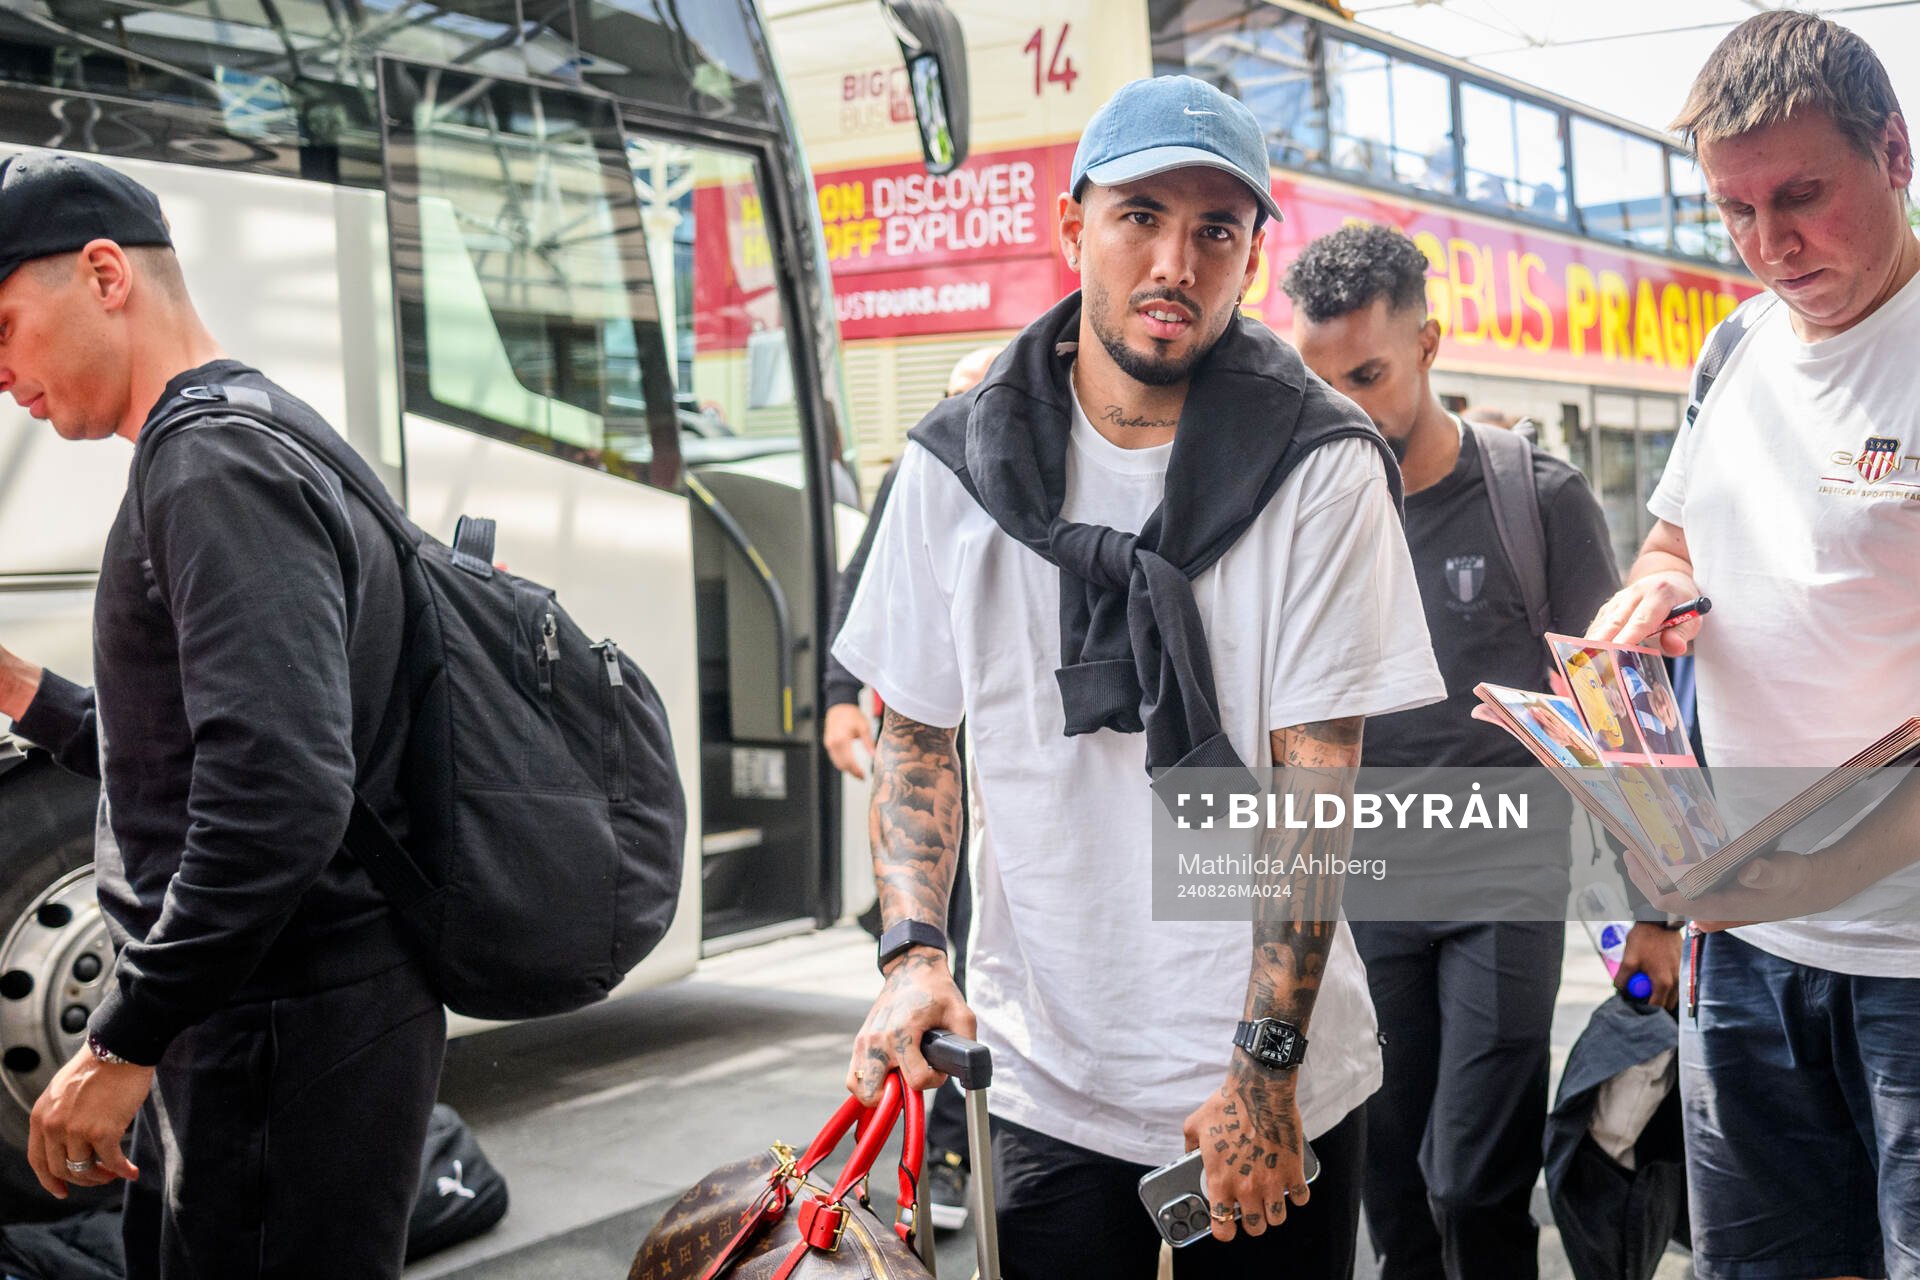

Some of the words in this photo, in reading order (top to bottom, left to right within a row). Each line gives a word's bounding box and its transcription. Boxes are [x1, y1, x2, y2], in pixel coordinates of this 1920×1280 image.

[843, 71, 884, 101] BIG
[1023, 23, 1078, 96] 14
[872, 161, 1035, 219] DISCOVER
[823, 218, 881, 261] OFF
[886, 202, 1037, 256] EXPLORE
[1413, 230, 1554, 356] GBUS
[1831, 450, 1920, 473] GANT
[1869, 440, 1896, 450] 1949
